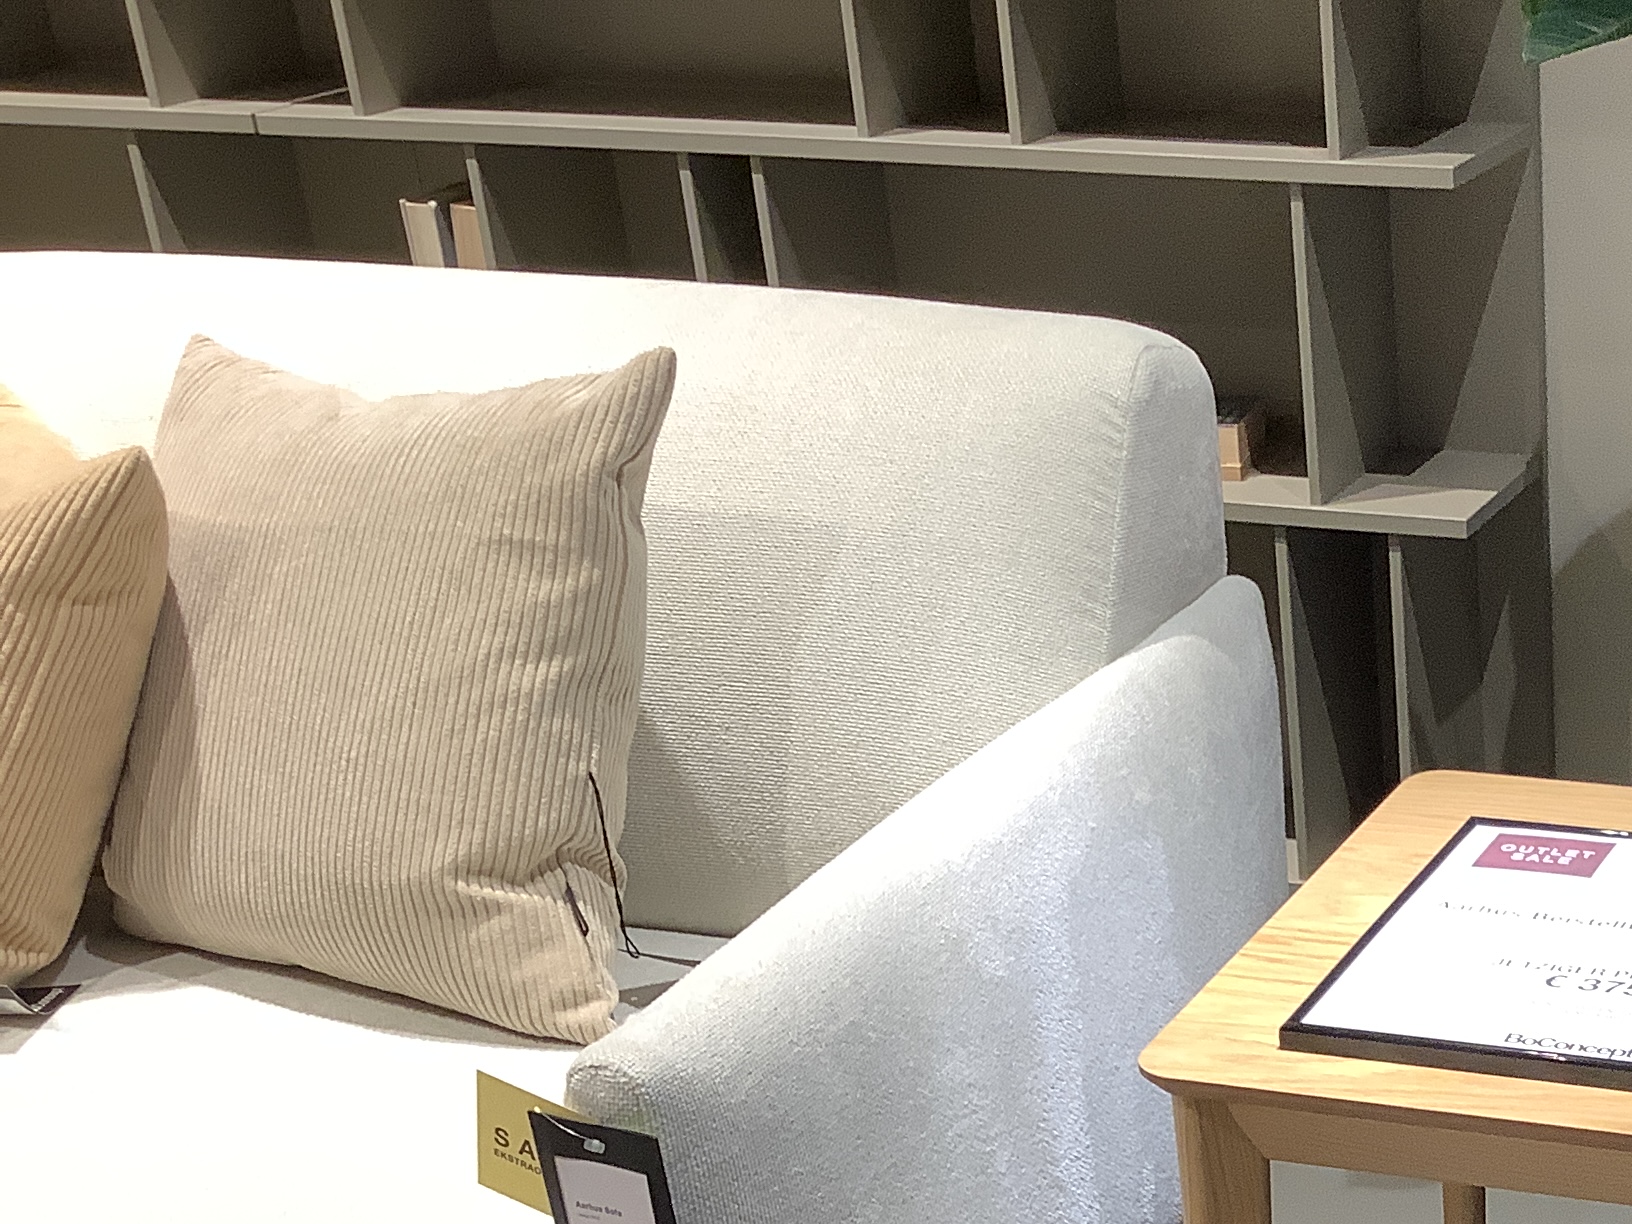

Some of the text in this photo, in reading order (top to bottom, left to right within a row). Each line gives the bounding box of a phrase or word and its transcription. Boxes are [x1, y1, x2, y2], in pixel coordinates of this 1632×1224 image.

[1500, 843, 1596, 860] OUTLET
[1510, 852, 1573, 866] SALE
[576, 1201, 603, 1213] Aarhus
